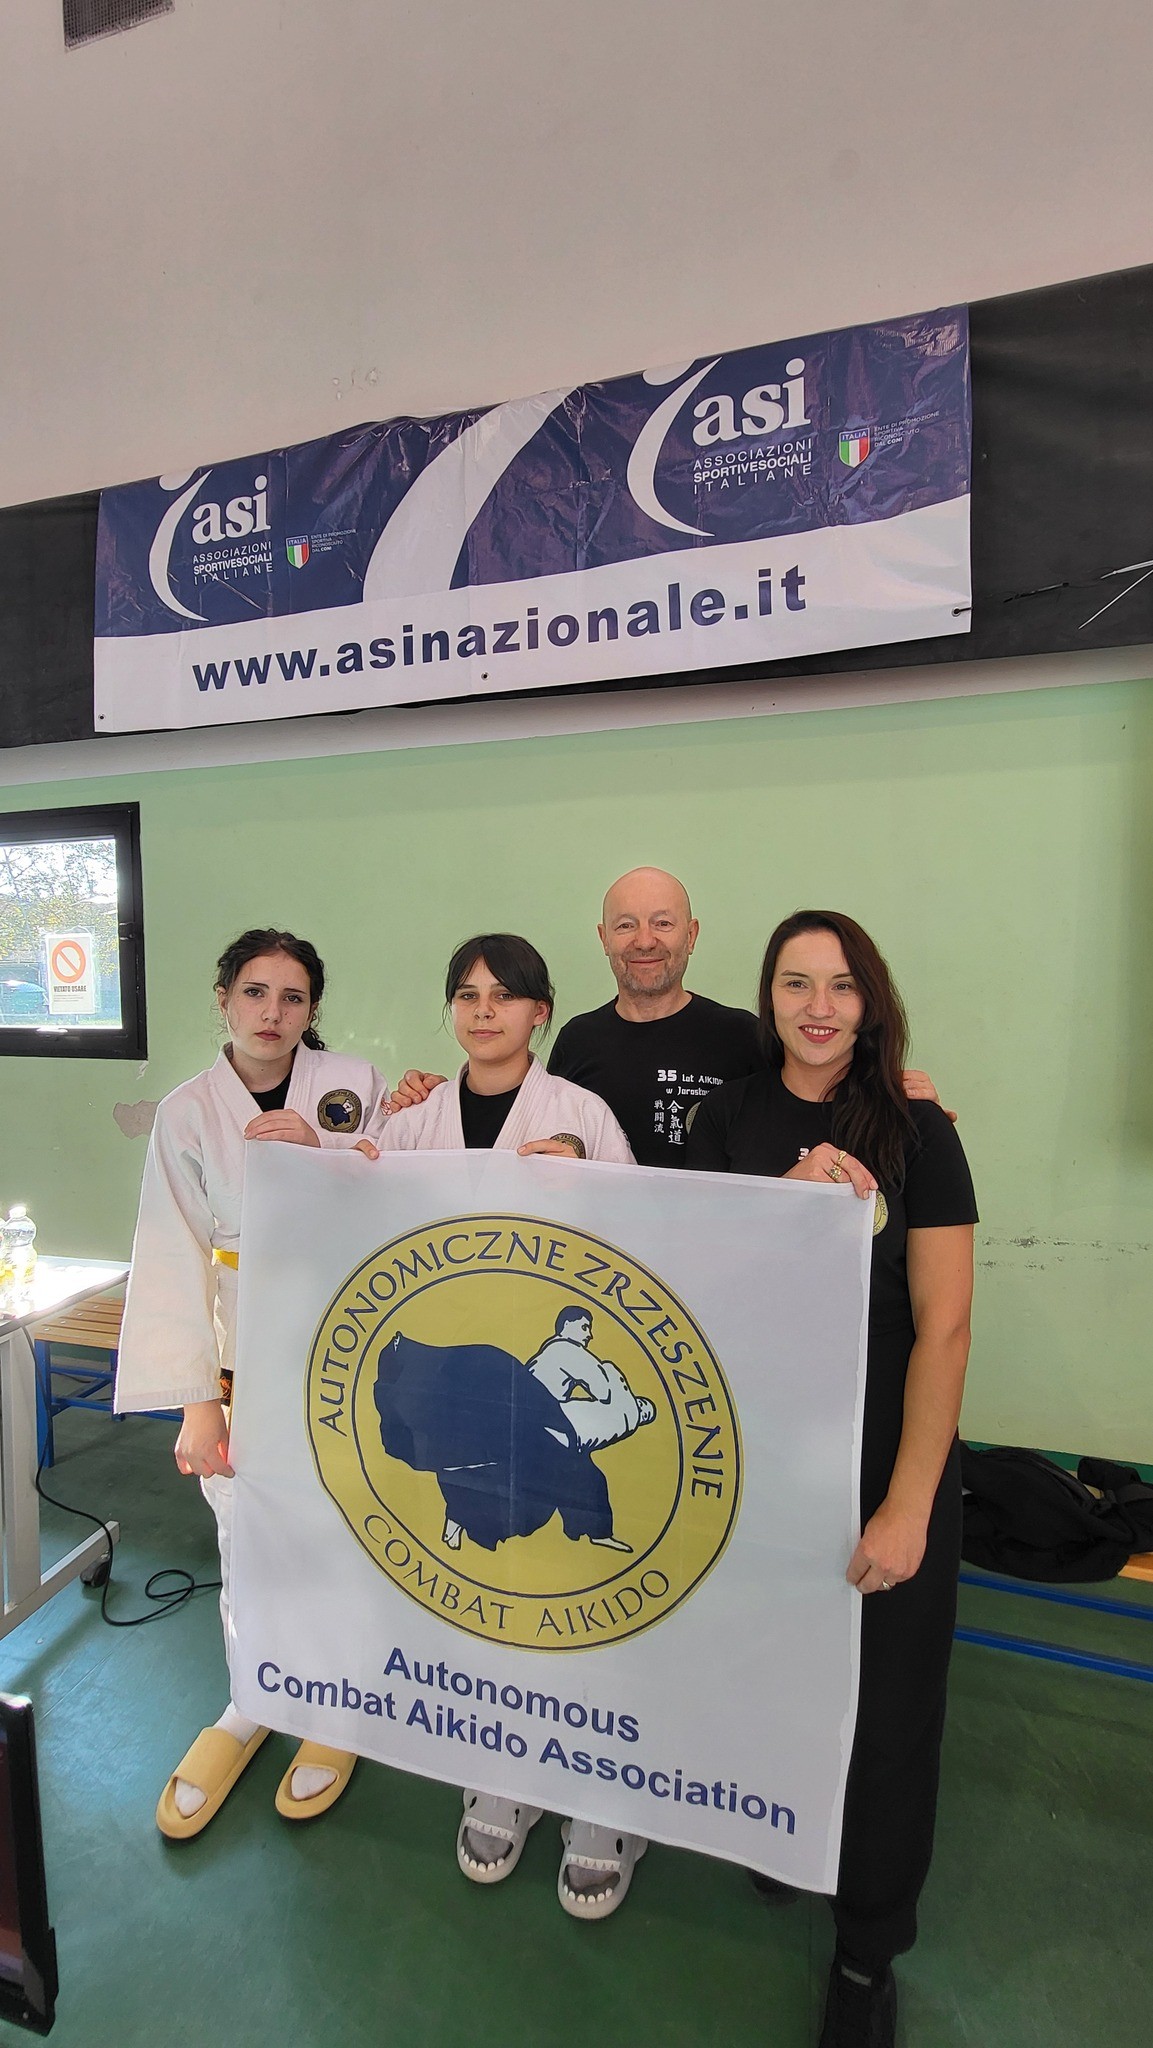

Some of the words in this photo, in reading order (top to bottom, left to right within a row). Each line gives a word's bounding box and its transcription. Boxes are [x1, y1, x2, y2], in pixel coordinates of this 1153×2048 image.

[692, 358, 811, 446] asi
[842, 431, 867, 440] ITALIA
[887, 437, 903, 445] CONI
[693, 438, 812, 471] ASSOCIAZIONI
[694, 452, 812, 483] SPORTIVESOCIALI
[694, 464, 812, 494] ITALIANE
[191, 475, 271, 545] asi
[192, 541, 272, 564] ASSOCIAZIONI
[193, 552, 273, 575] SPORTIVESOCIALI
[194, 563, 274, 585] ITALIANE
[192, 564, 807, 692] www.asinazionale.it
[657, 1069, 678, 1082] 35
[682, 1073, 695, 1083] lat
[318, 1231, 567, 1437] AUTONOMICZNE
[574, 1252, 723, 1500] ZRZESZENIE
[363, 1514, 514, 1629] COMBAT
[536, 1569, 670, 1637] AIKIDO
[383, 1647, 640, 1743] Autonomous
[257, 1661, 397, 1720] Combat
[406, 1698, 528, 1758] Aikido
[539, 1738, 796, 1834] Association
